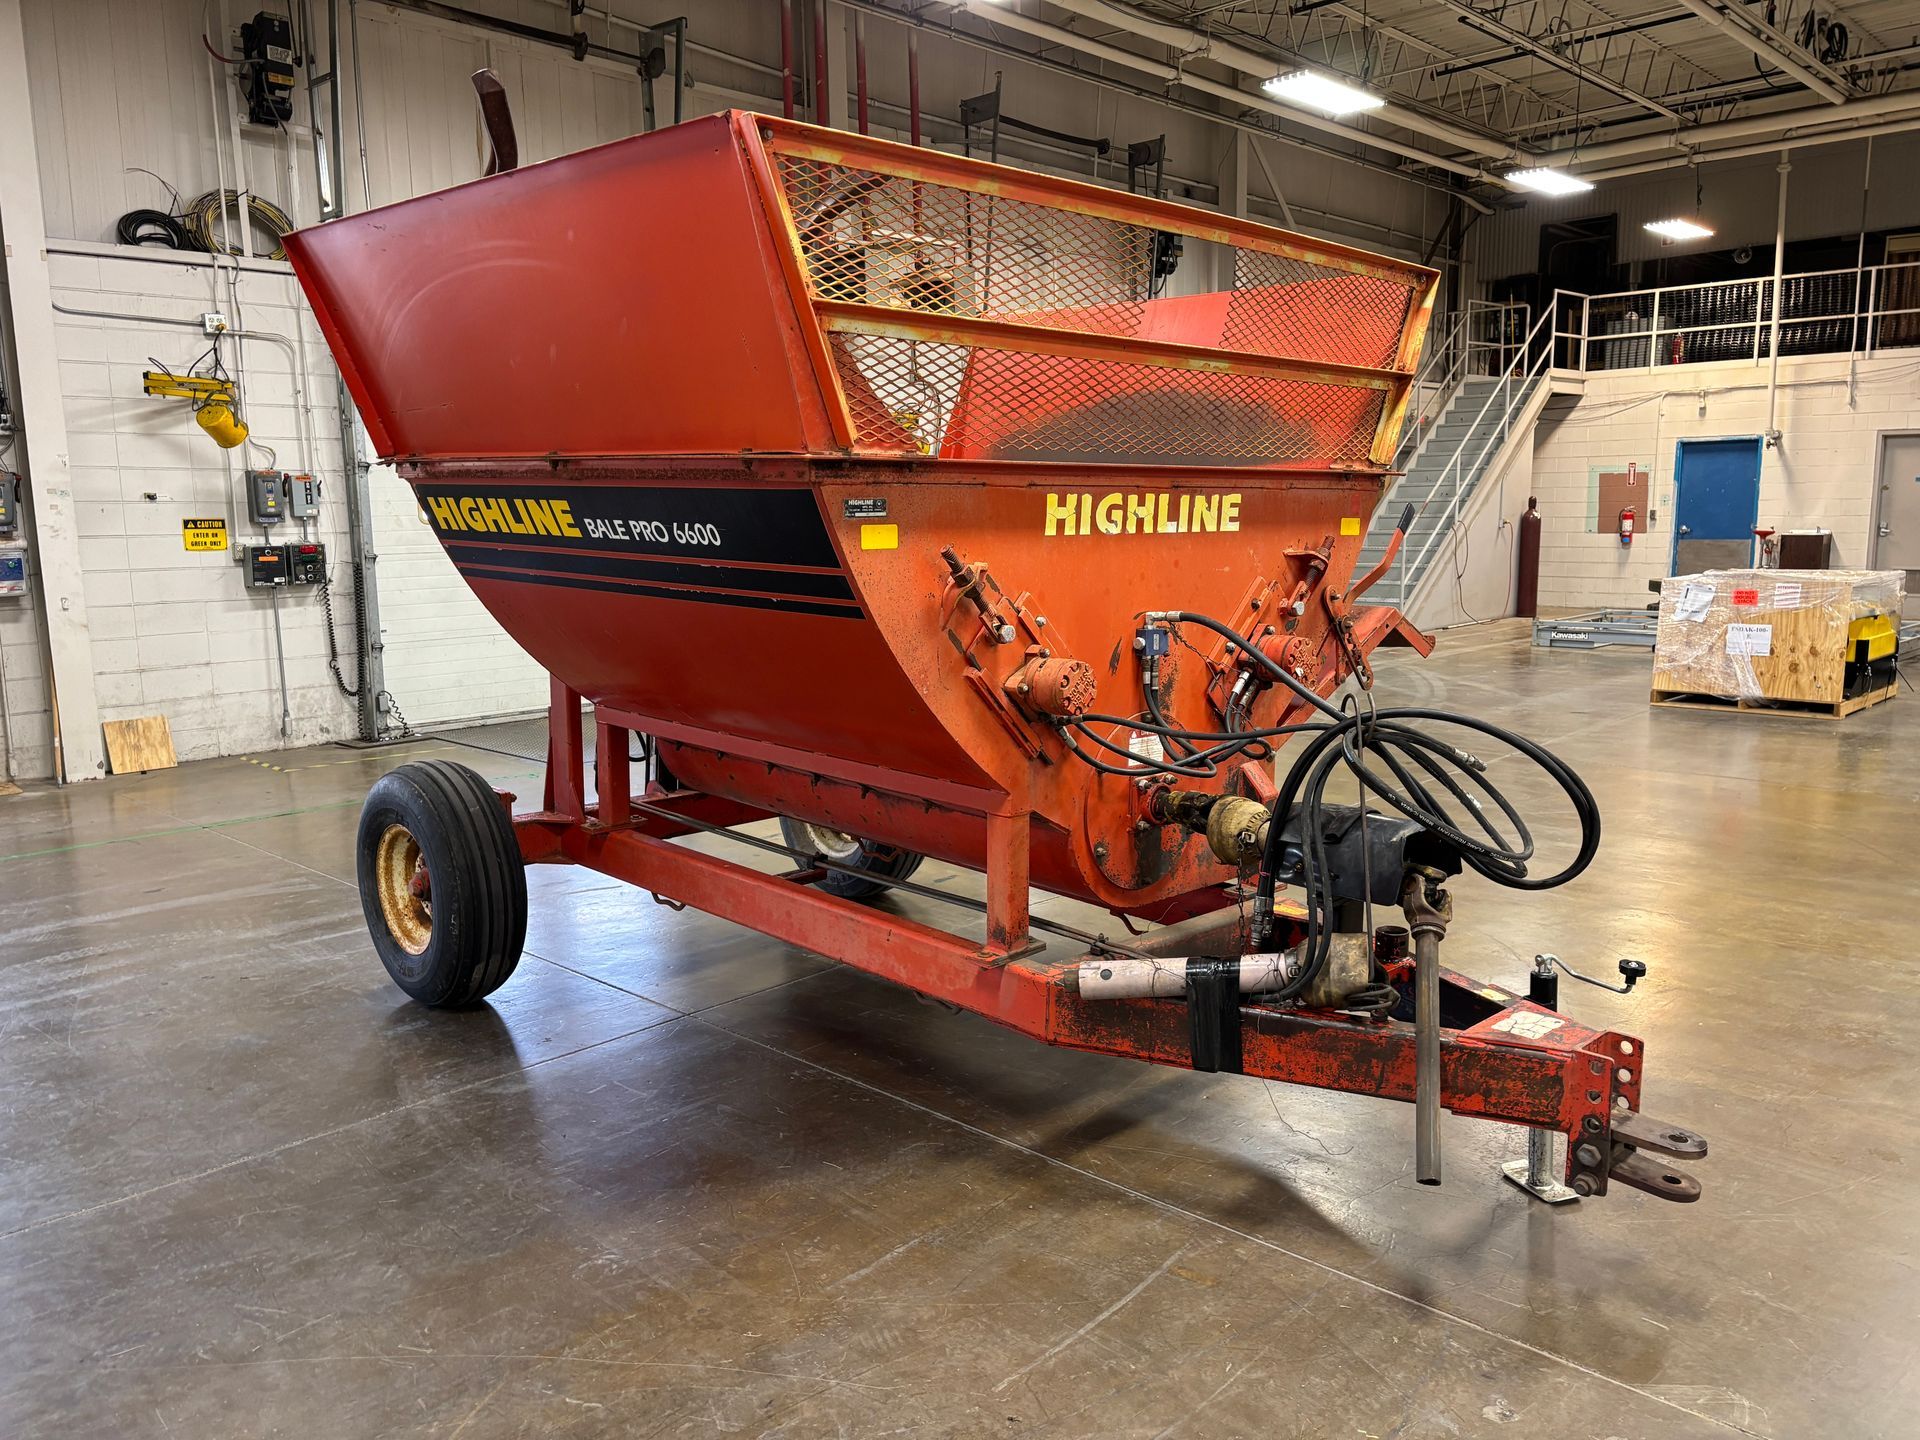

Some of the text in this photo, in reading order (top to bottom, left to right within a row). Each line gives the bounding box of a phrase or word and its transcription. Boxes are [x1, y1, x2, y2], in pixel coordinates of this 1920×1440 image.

[196, 519, 223, 528] CAUTION
[427, 495, 721, 547] HIGHLINE BALE PRO 6600
[1045, 492, 1242, 536] HIGHLINE
[1551, 631, 1589, 640] Kawasaki
